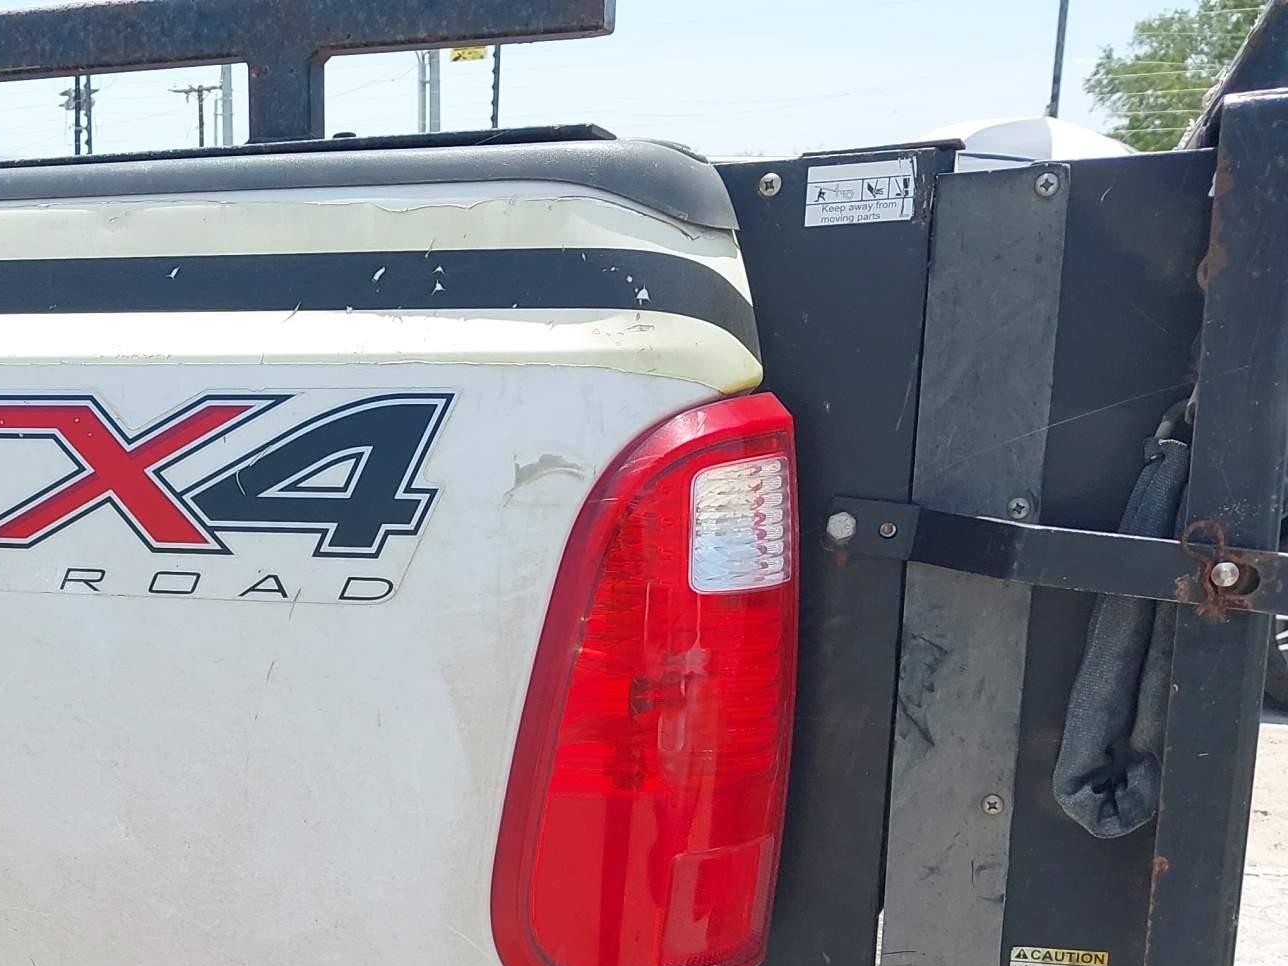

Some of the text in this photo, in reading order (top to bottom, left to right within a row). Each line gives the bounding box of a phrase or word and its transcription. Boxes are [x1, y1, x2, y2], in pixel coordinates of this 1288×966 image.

[821, 201, 897, 214] Keep away from
[821, 213, 880, 223] moving parts
[60, 567, 395, 601] ROAD
[1031, 949, 1105, 964] CAUTION
